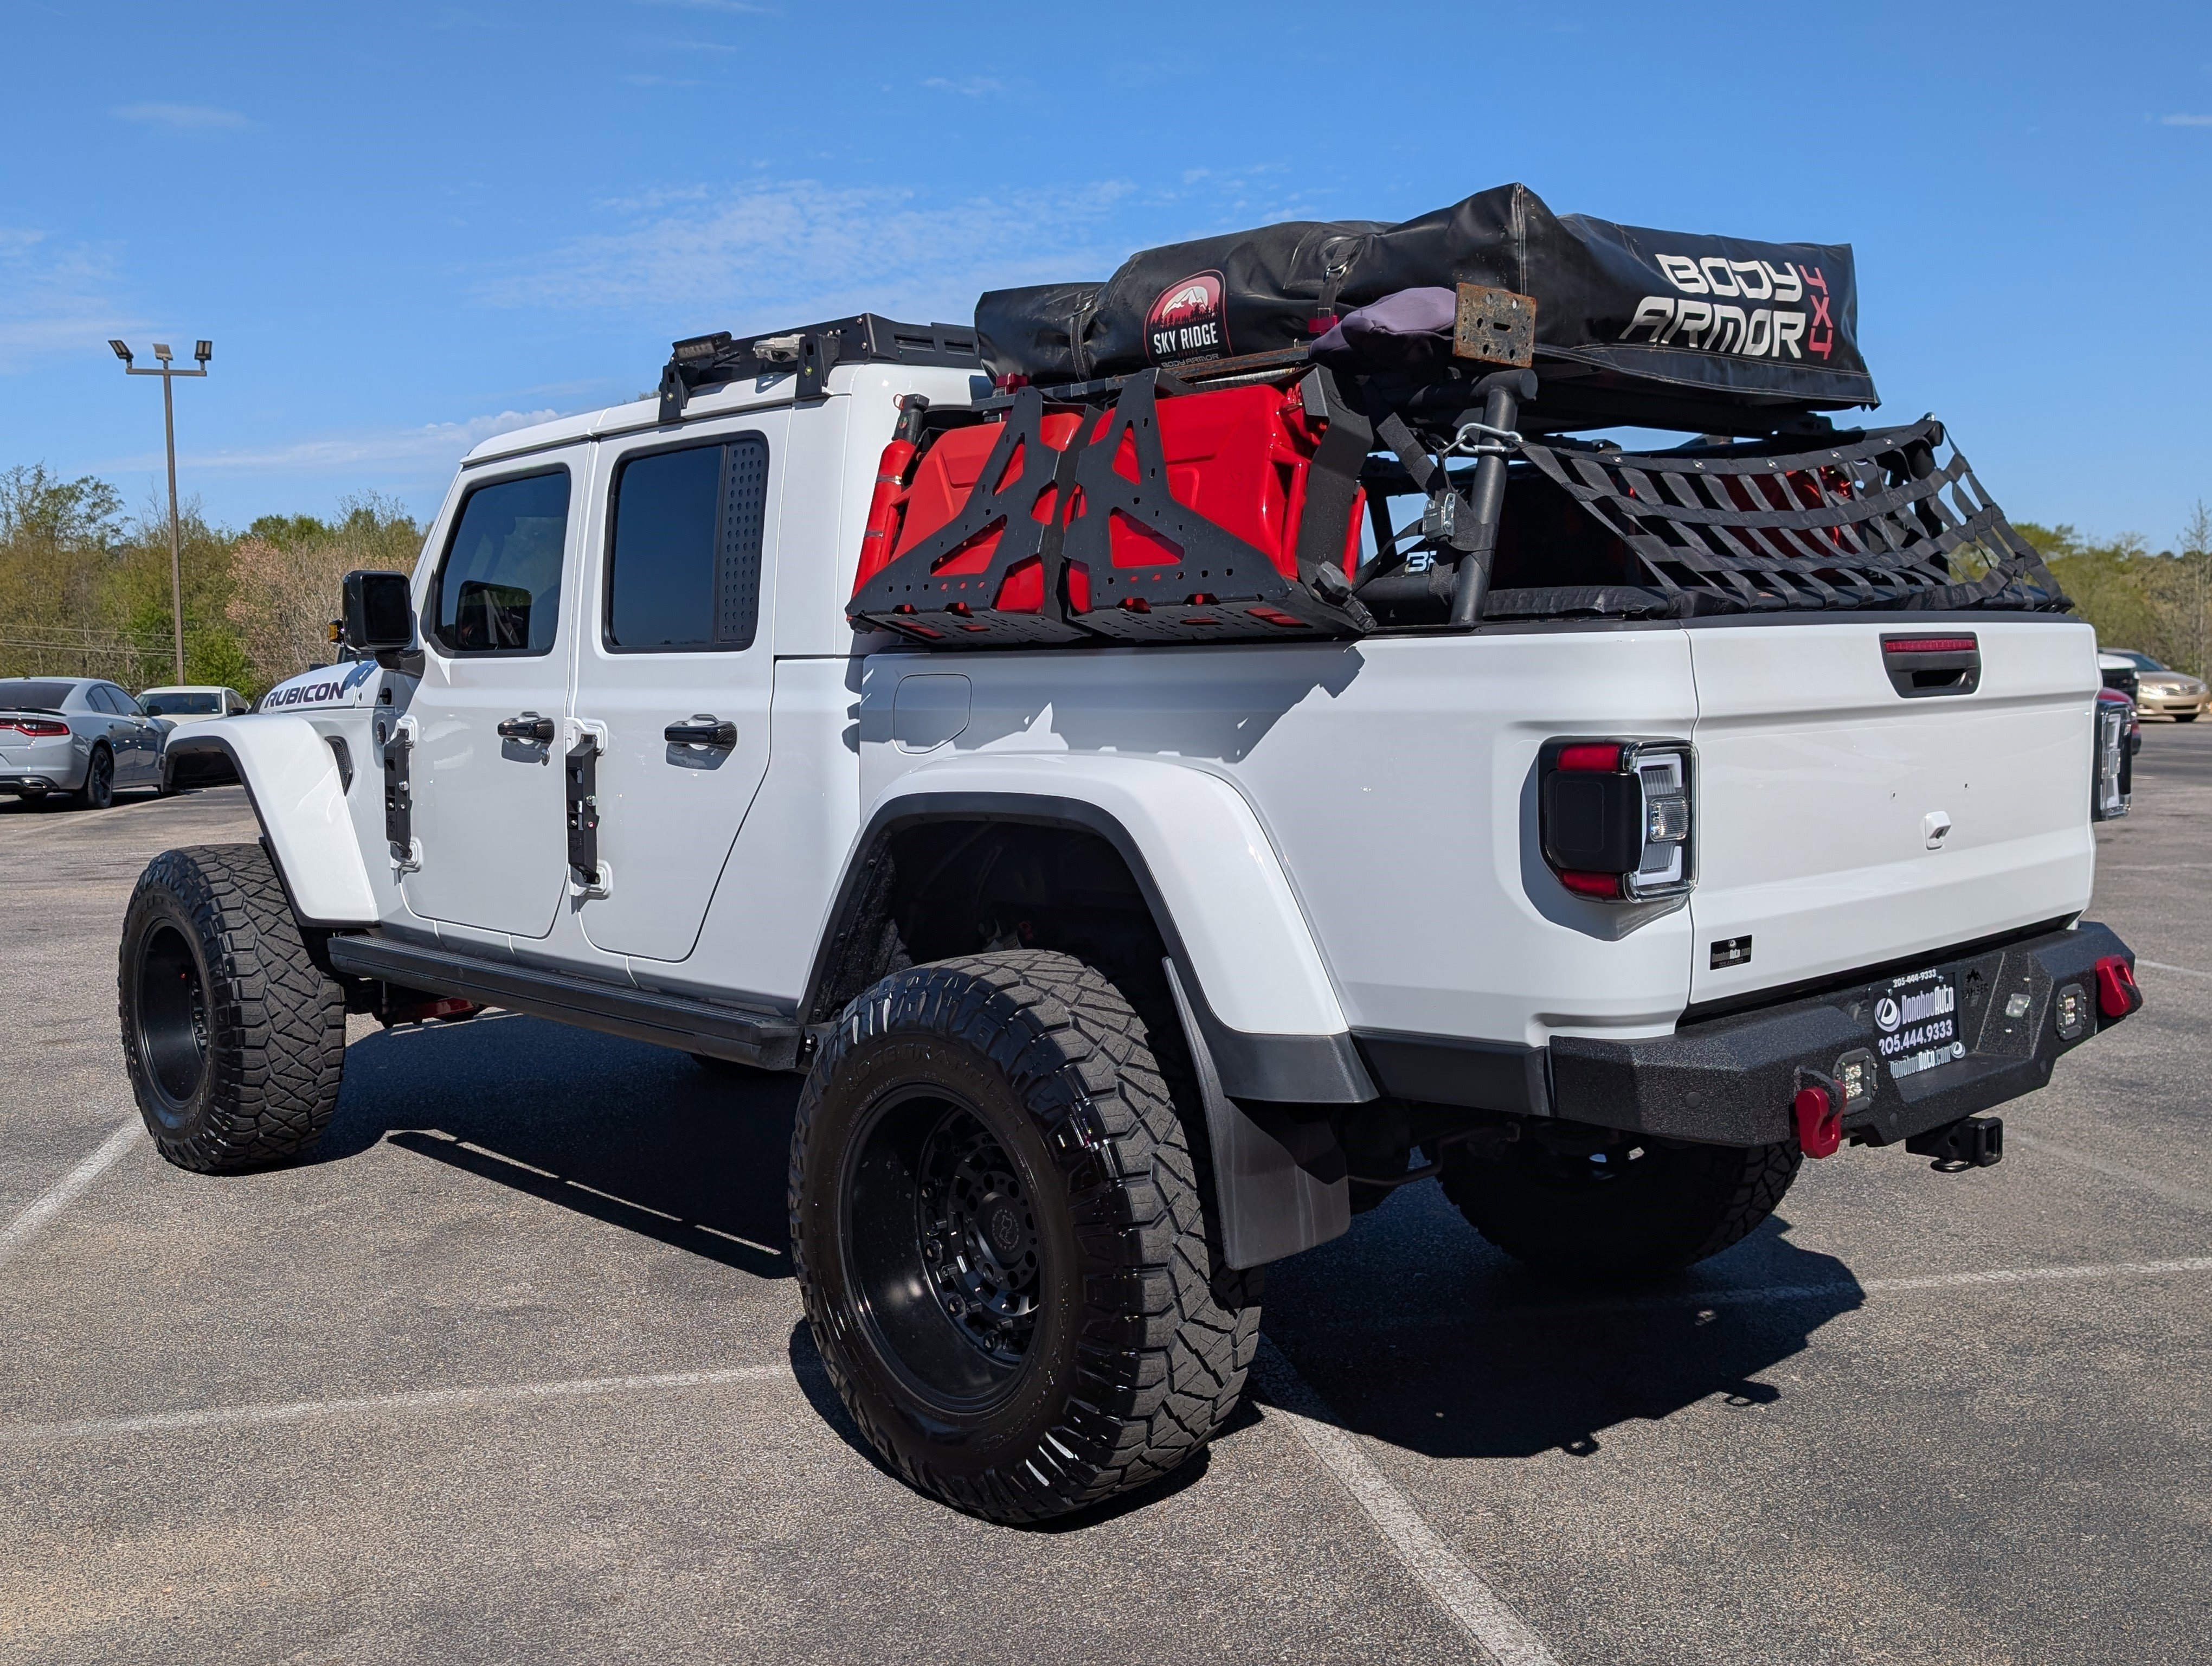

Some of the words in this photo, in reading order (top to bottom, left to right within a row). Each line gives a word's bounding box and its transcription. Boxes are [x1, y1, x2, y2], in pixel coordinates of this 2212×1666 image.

[1655, 254, 1803, 302] BODY
[1154, 330, 1176, 354] SKY
[1180, 322, 1218, 350] RIDGE
[1619, 296, 1806, 358] ARMOR
[264, 681, 348, 708] RUBICON
[1893, 969, 1936, 988] 205-444-9333
[1901, 984, 1954, 1024] DonohooAuto
[1879, 1019, 1953, 1055] 205.444.9333
